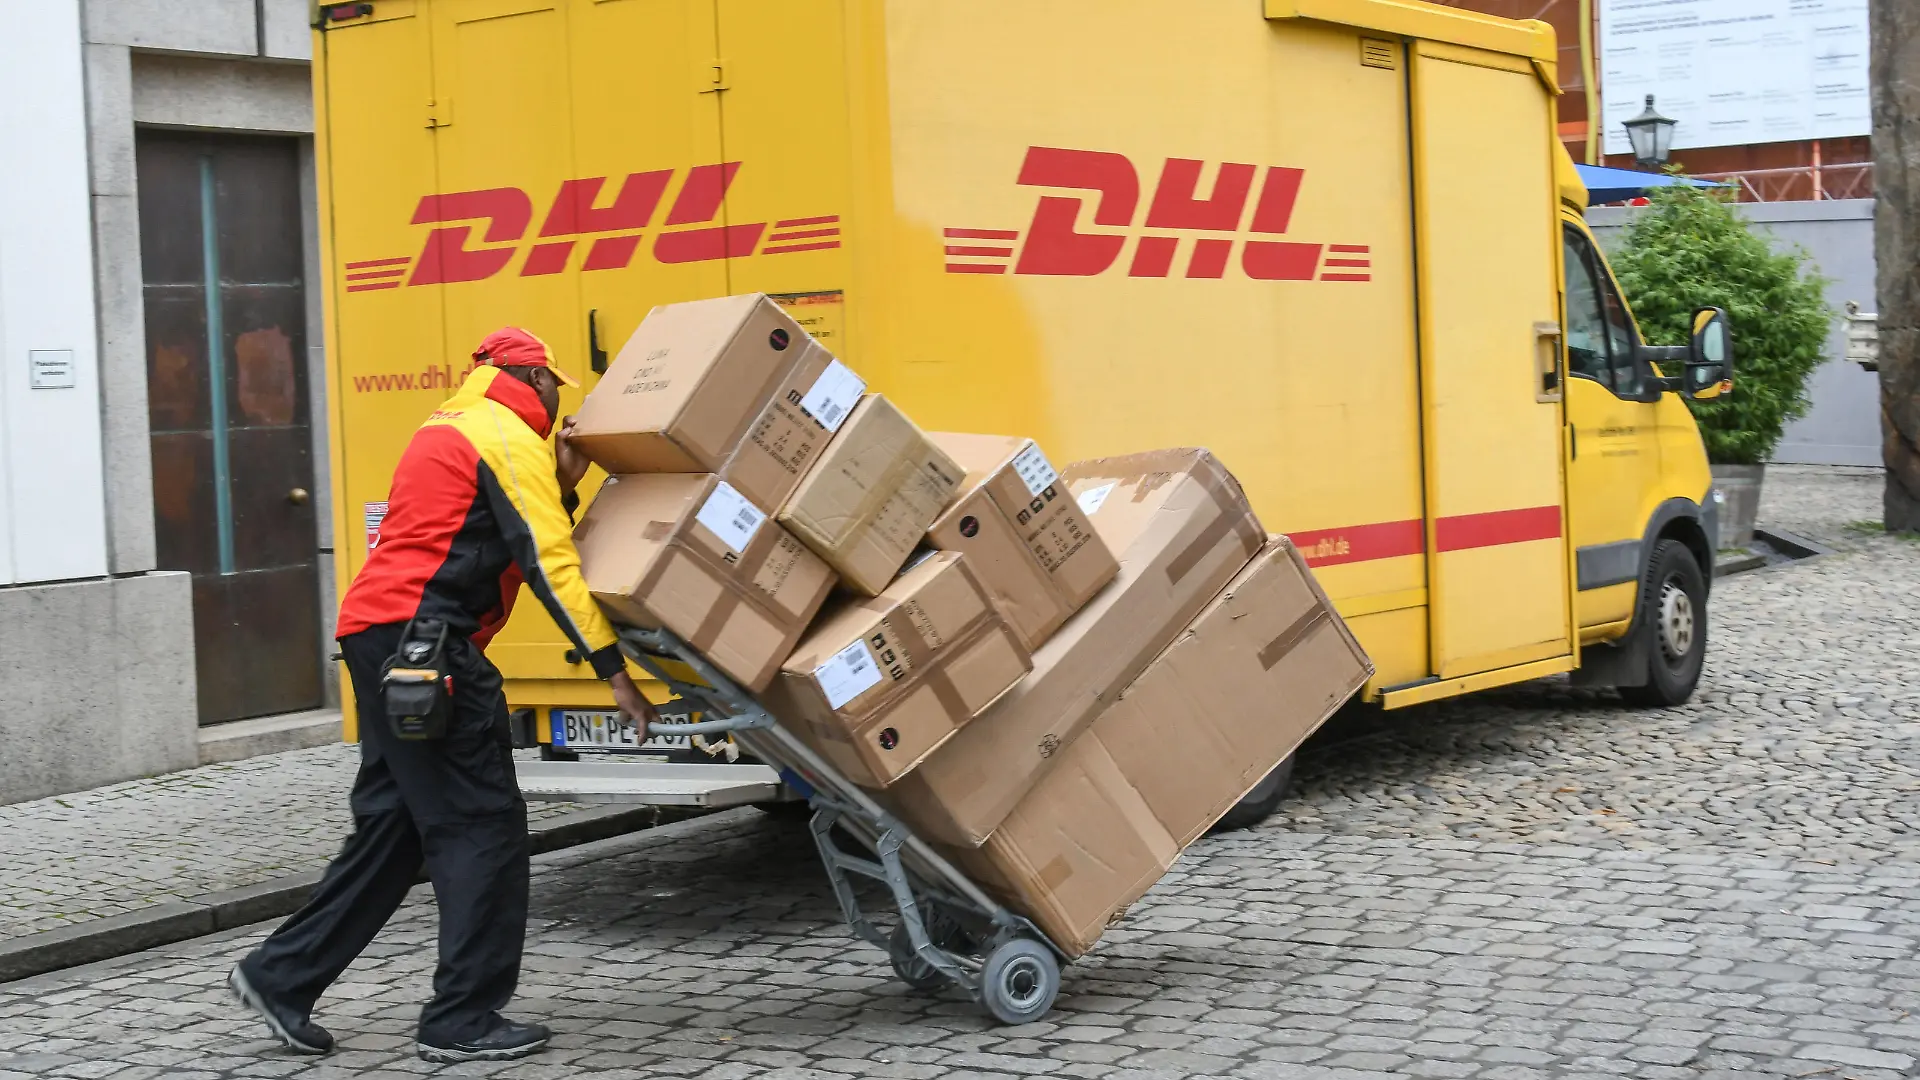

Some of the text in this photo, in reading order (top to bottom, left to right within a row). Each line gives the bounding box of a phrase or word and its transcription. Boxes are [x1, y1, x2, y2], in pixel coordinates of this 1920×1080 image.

[407, 161, 768, 287] DHL
[1013, 146, 1323, 281] DHL
[353, 364, 474, 393] www.dhl.d
[566, 714, 592, 743] BN
